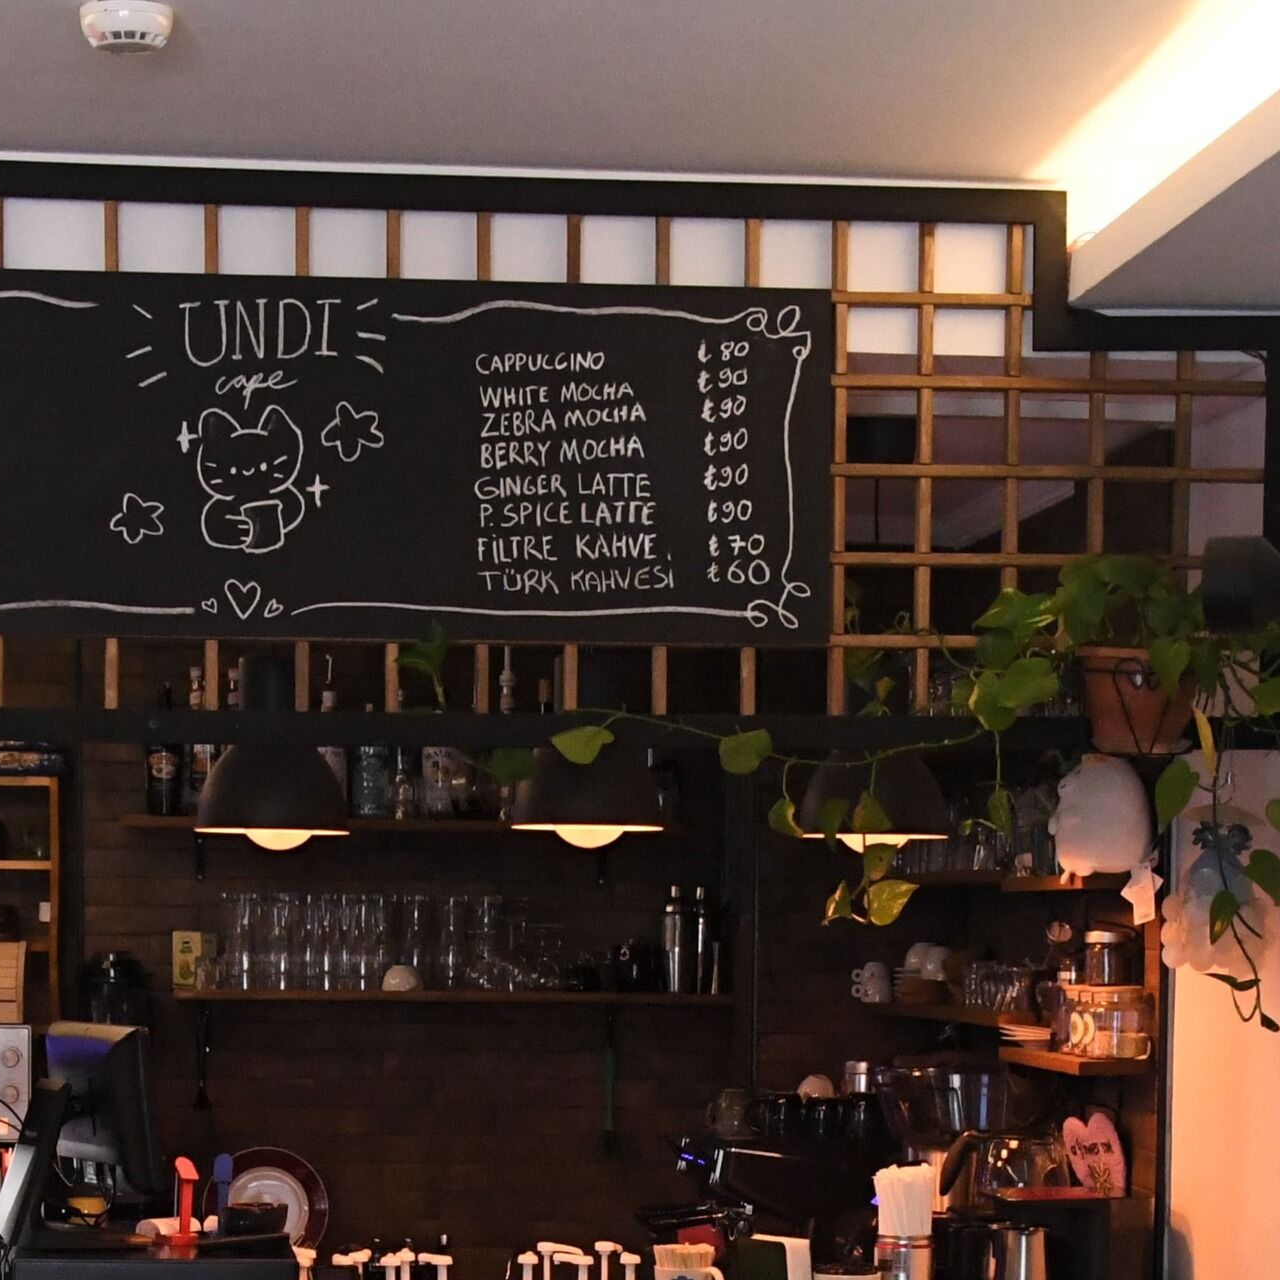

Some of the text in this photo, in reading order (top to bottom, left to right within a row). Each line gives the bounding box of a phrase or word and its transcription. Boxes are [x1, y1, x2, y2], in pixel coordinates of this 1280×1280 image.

[179, 299, 341, 367] UNDI
[476, 351, 604, 374] CAPPUCCINO
[480, 386, 548, 408] WHITE
[561, 382, 634, 402] MOCHA
[481, 409, 556, 437] ZEBRA
[565, 402, 646, 427] MOCHA
[481, 441, 551, 469] BERRY
[560, 435, 644, 464] MOCHA
[474, 474, 566, 499] GINGER
[578, 473, 650, 497] LATTE
[581, 501, 656, 527] LATTE
[478, 569, 559, 594] TÜRK
